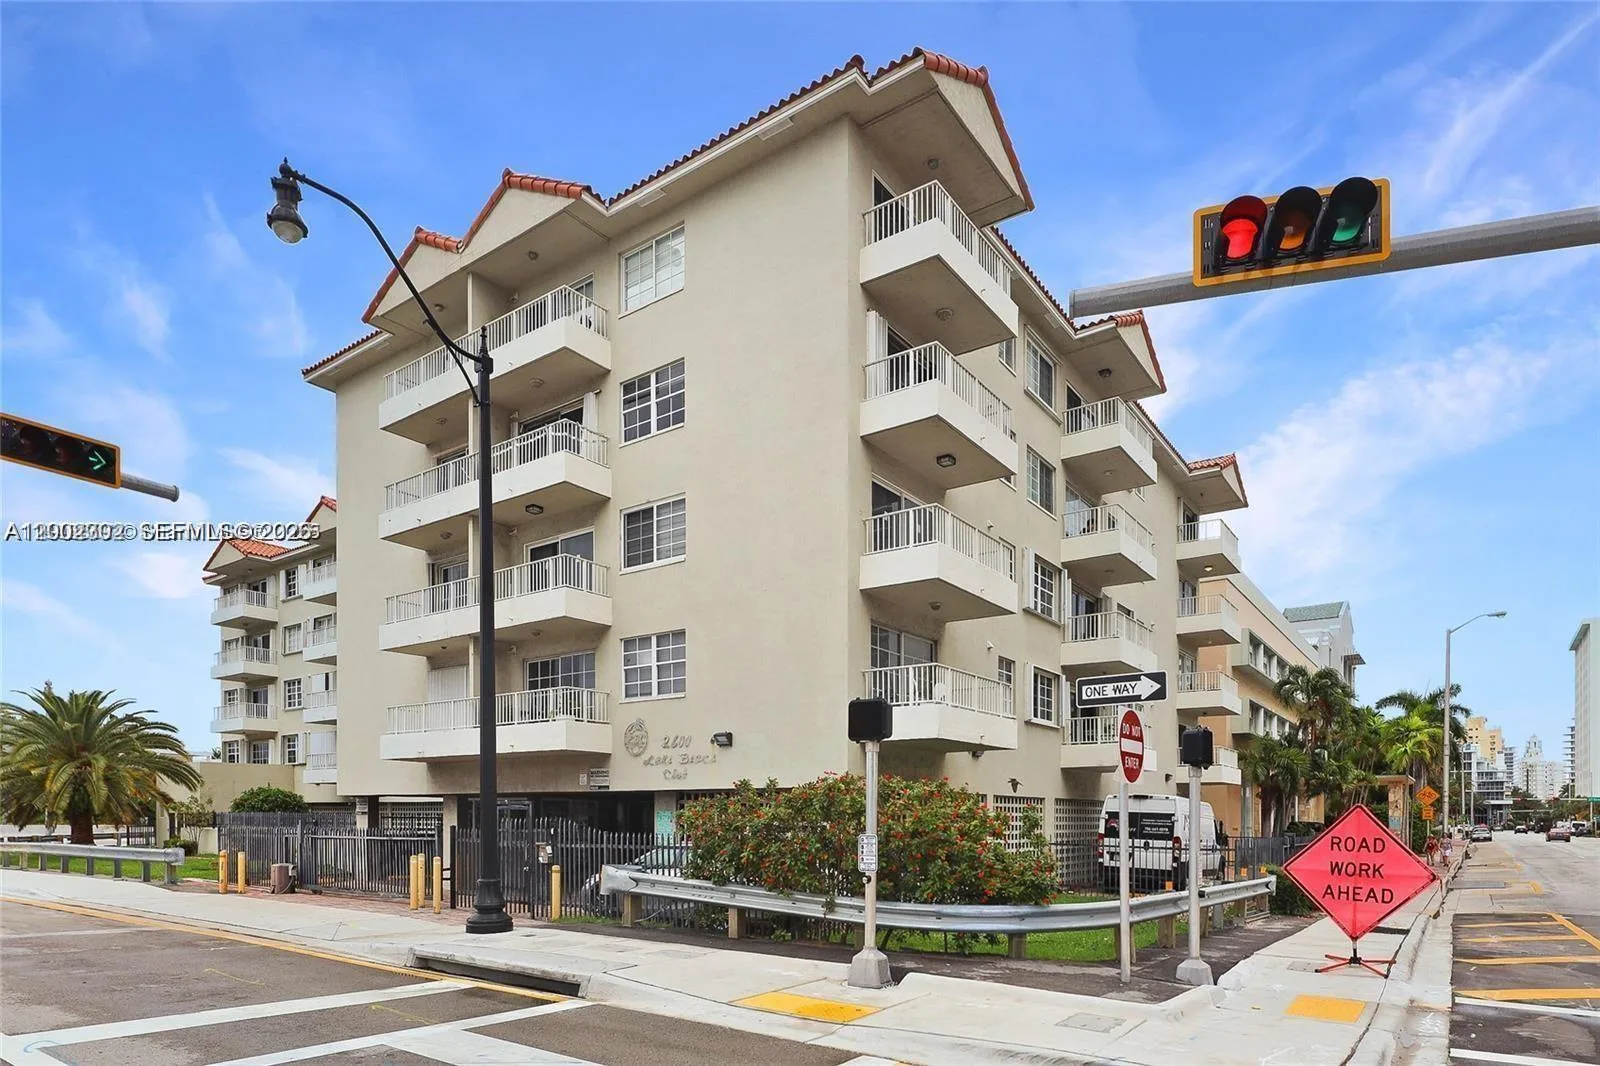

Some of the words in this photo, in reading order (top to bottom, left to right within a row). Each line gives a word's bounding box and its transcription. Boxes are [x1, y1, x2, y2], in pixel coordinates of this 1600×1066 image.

[1085, 685, 1108, 697] ONE
[1112, 682, 1137, 695] WAY
[1122, 723, 1130, 735] DO
[1131, 724, 1141, 737] NOT
[661, 735, 692, 748] 2600
[1125, 756, 1139, 769] ENTER
[1330, 836, 1386, 853] ROAD
[1330, 861, 1384, 879] WORK
[1322, 884, 1394, 904] AHEAD
